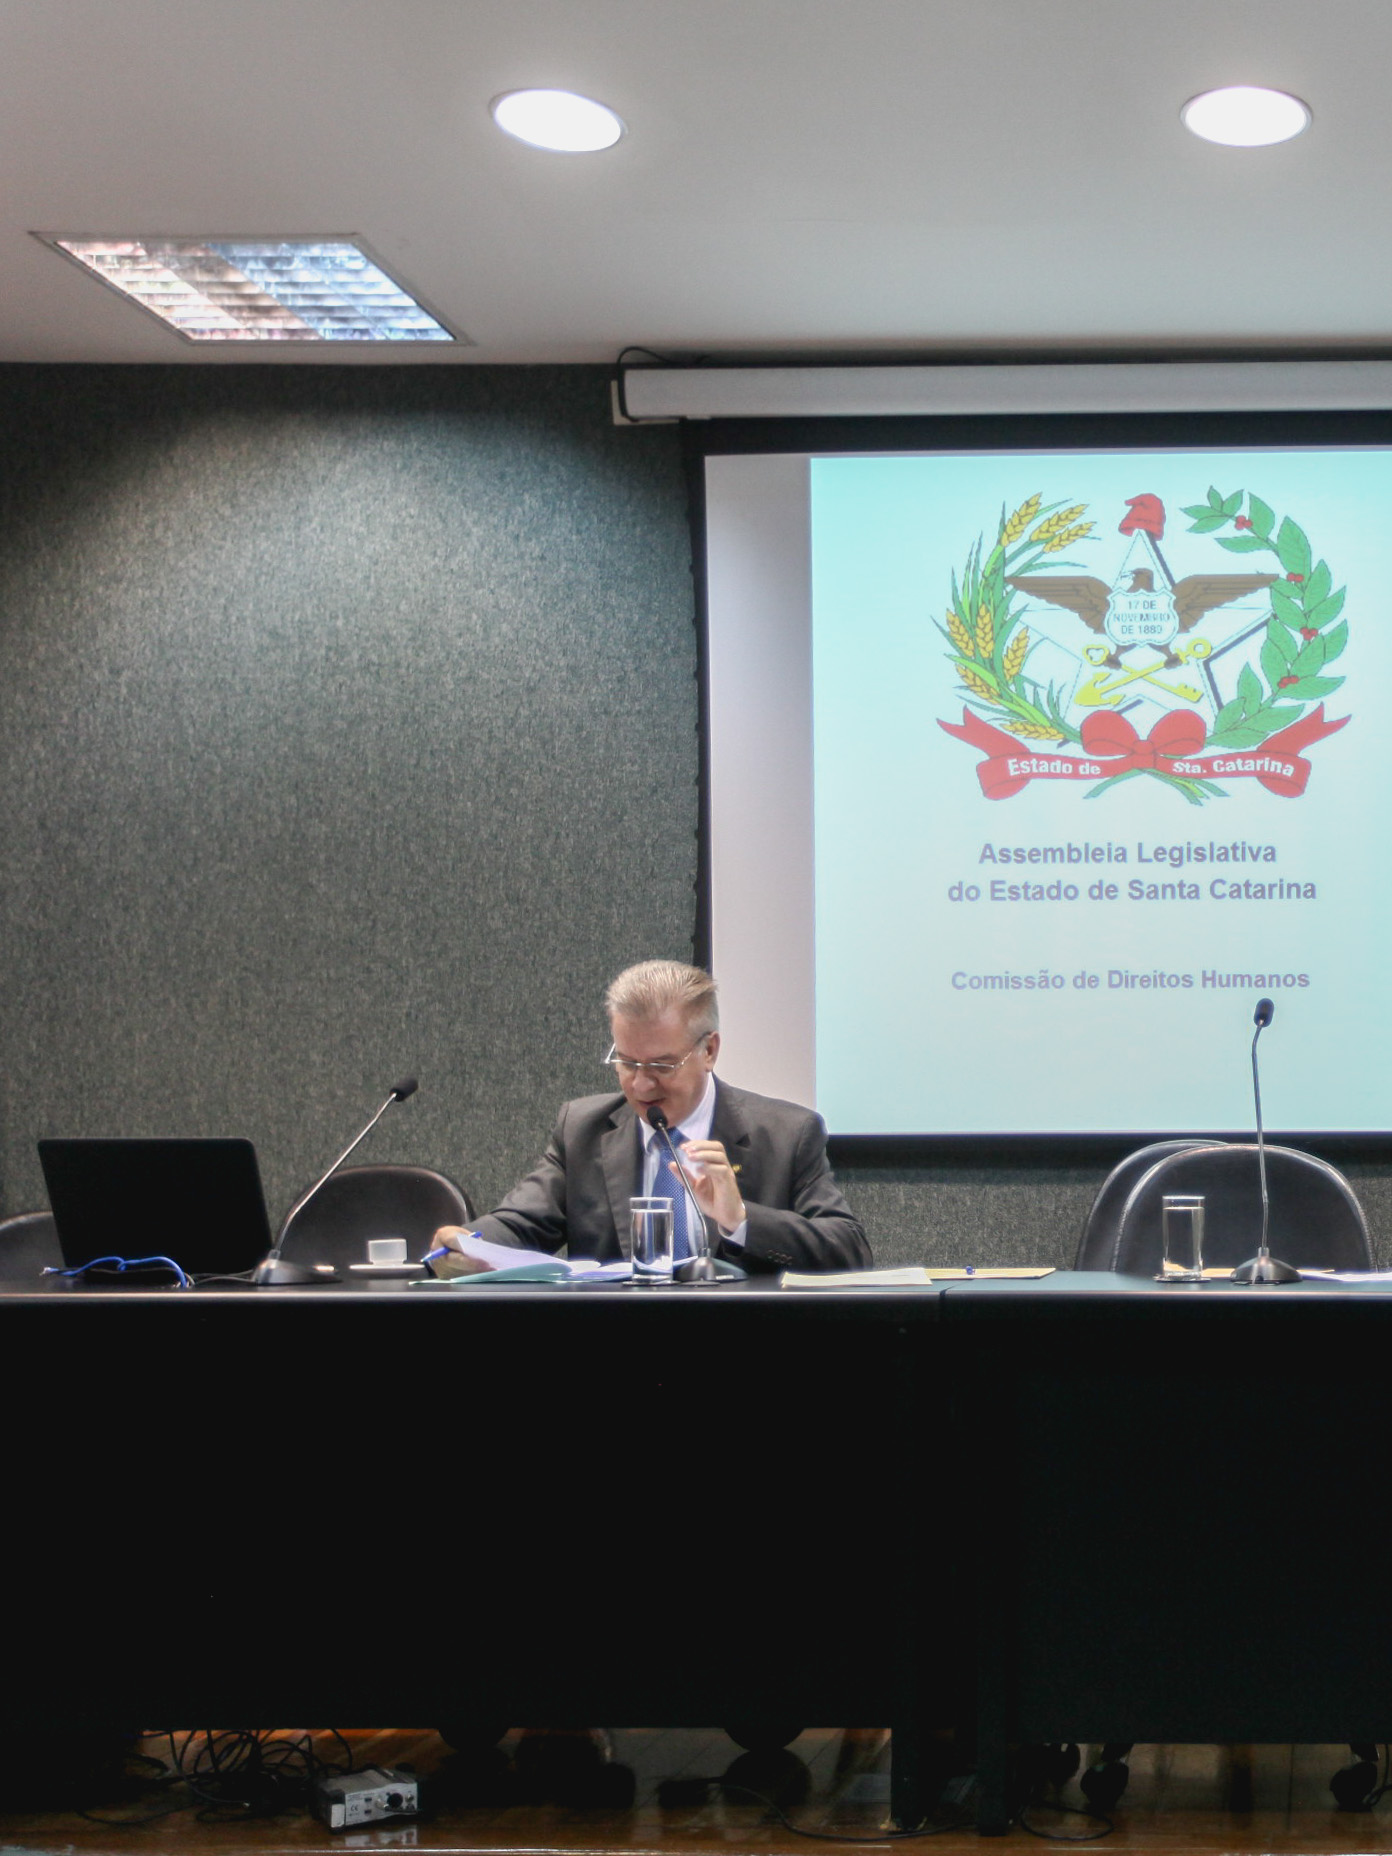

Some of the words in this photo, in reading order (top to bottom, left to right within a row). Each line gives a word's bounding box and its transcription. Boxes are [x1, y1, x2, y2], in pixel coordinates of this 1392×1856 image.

[1128, 600, 1139, 610] 17
[1142, 599, 1157, 610] DE
[1121, 624, 1134, 635] DE
[1007, 758, 1073, 776] Estado
[1078, 762, 1101, 775] de
[1172, 761, 1207, 774] Sta.
[1212, 757, 1295, 777] Catarina
[978, 841, 1128, 865] Assembleia
[1137, 840, 1277, 868] Legislativa
[947, 880, 981, 902] do
[989, 879, 1080, 902] Estado
[1087, 879, 1119, 901] de
[1127, 878, 1201, 901] Santa
[1209, 877, 1317, 900] Catarina
[951, 968, 1066, 991] Comissão
[1072, 970, 1100, 990] de
[1107, 969, 1194, 989] Direitos
[1201, 969, 1311, 989] Humanos
